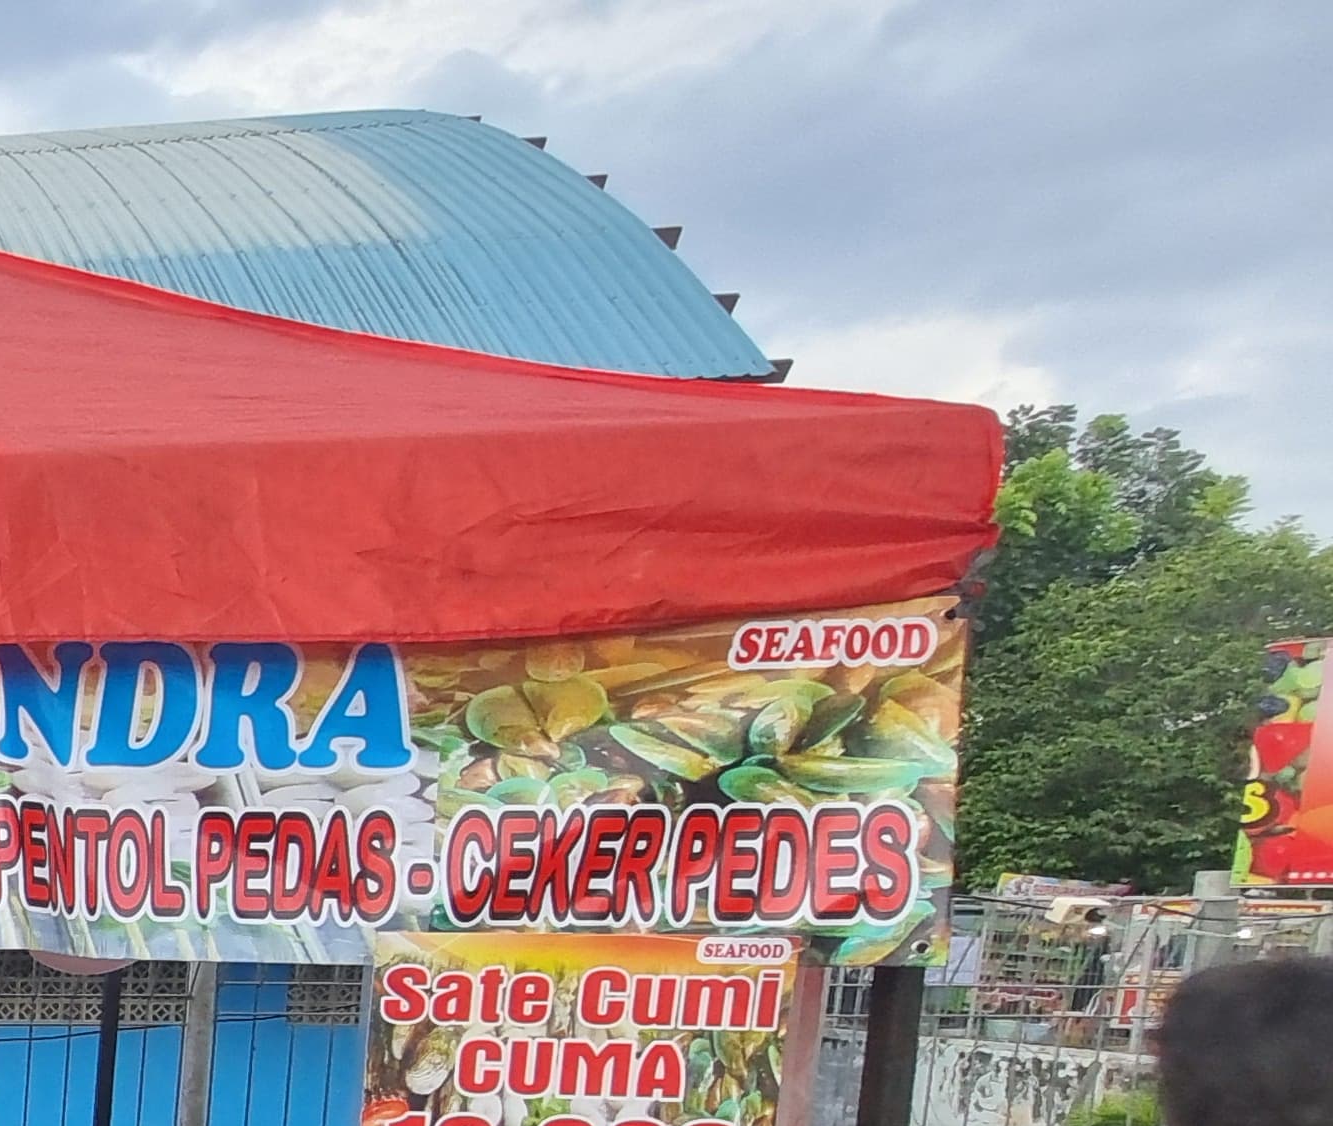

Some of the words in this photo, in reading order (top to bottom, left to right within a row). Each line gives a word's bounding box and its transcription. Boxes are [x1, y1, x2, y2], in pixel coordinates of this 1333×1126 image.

[734, 620, 933, 666] SEAFOOD
[195, 808, 396, 922] PEDAS
[445, 806, 670, 923] CEKER
[673, 805, 914, 922] PEDES
[703, 943, 786, 959] SEAFOOD
[381, 963, 553, 1026] Sate
[579, 968, 782, 1032] Cumi
[457, 1038, 684, 1100] CUMA
